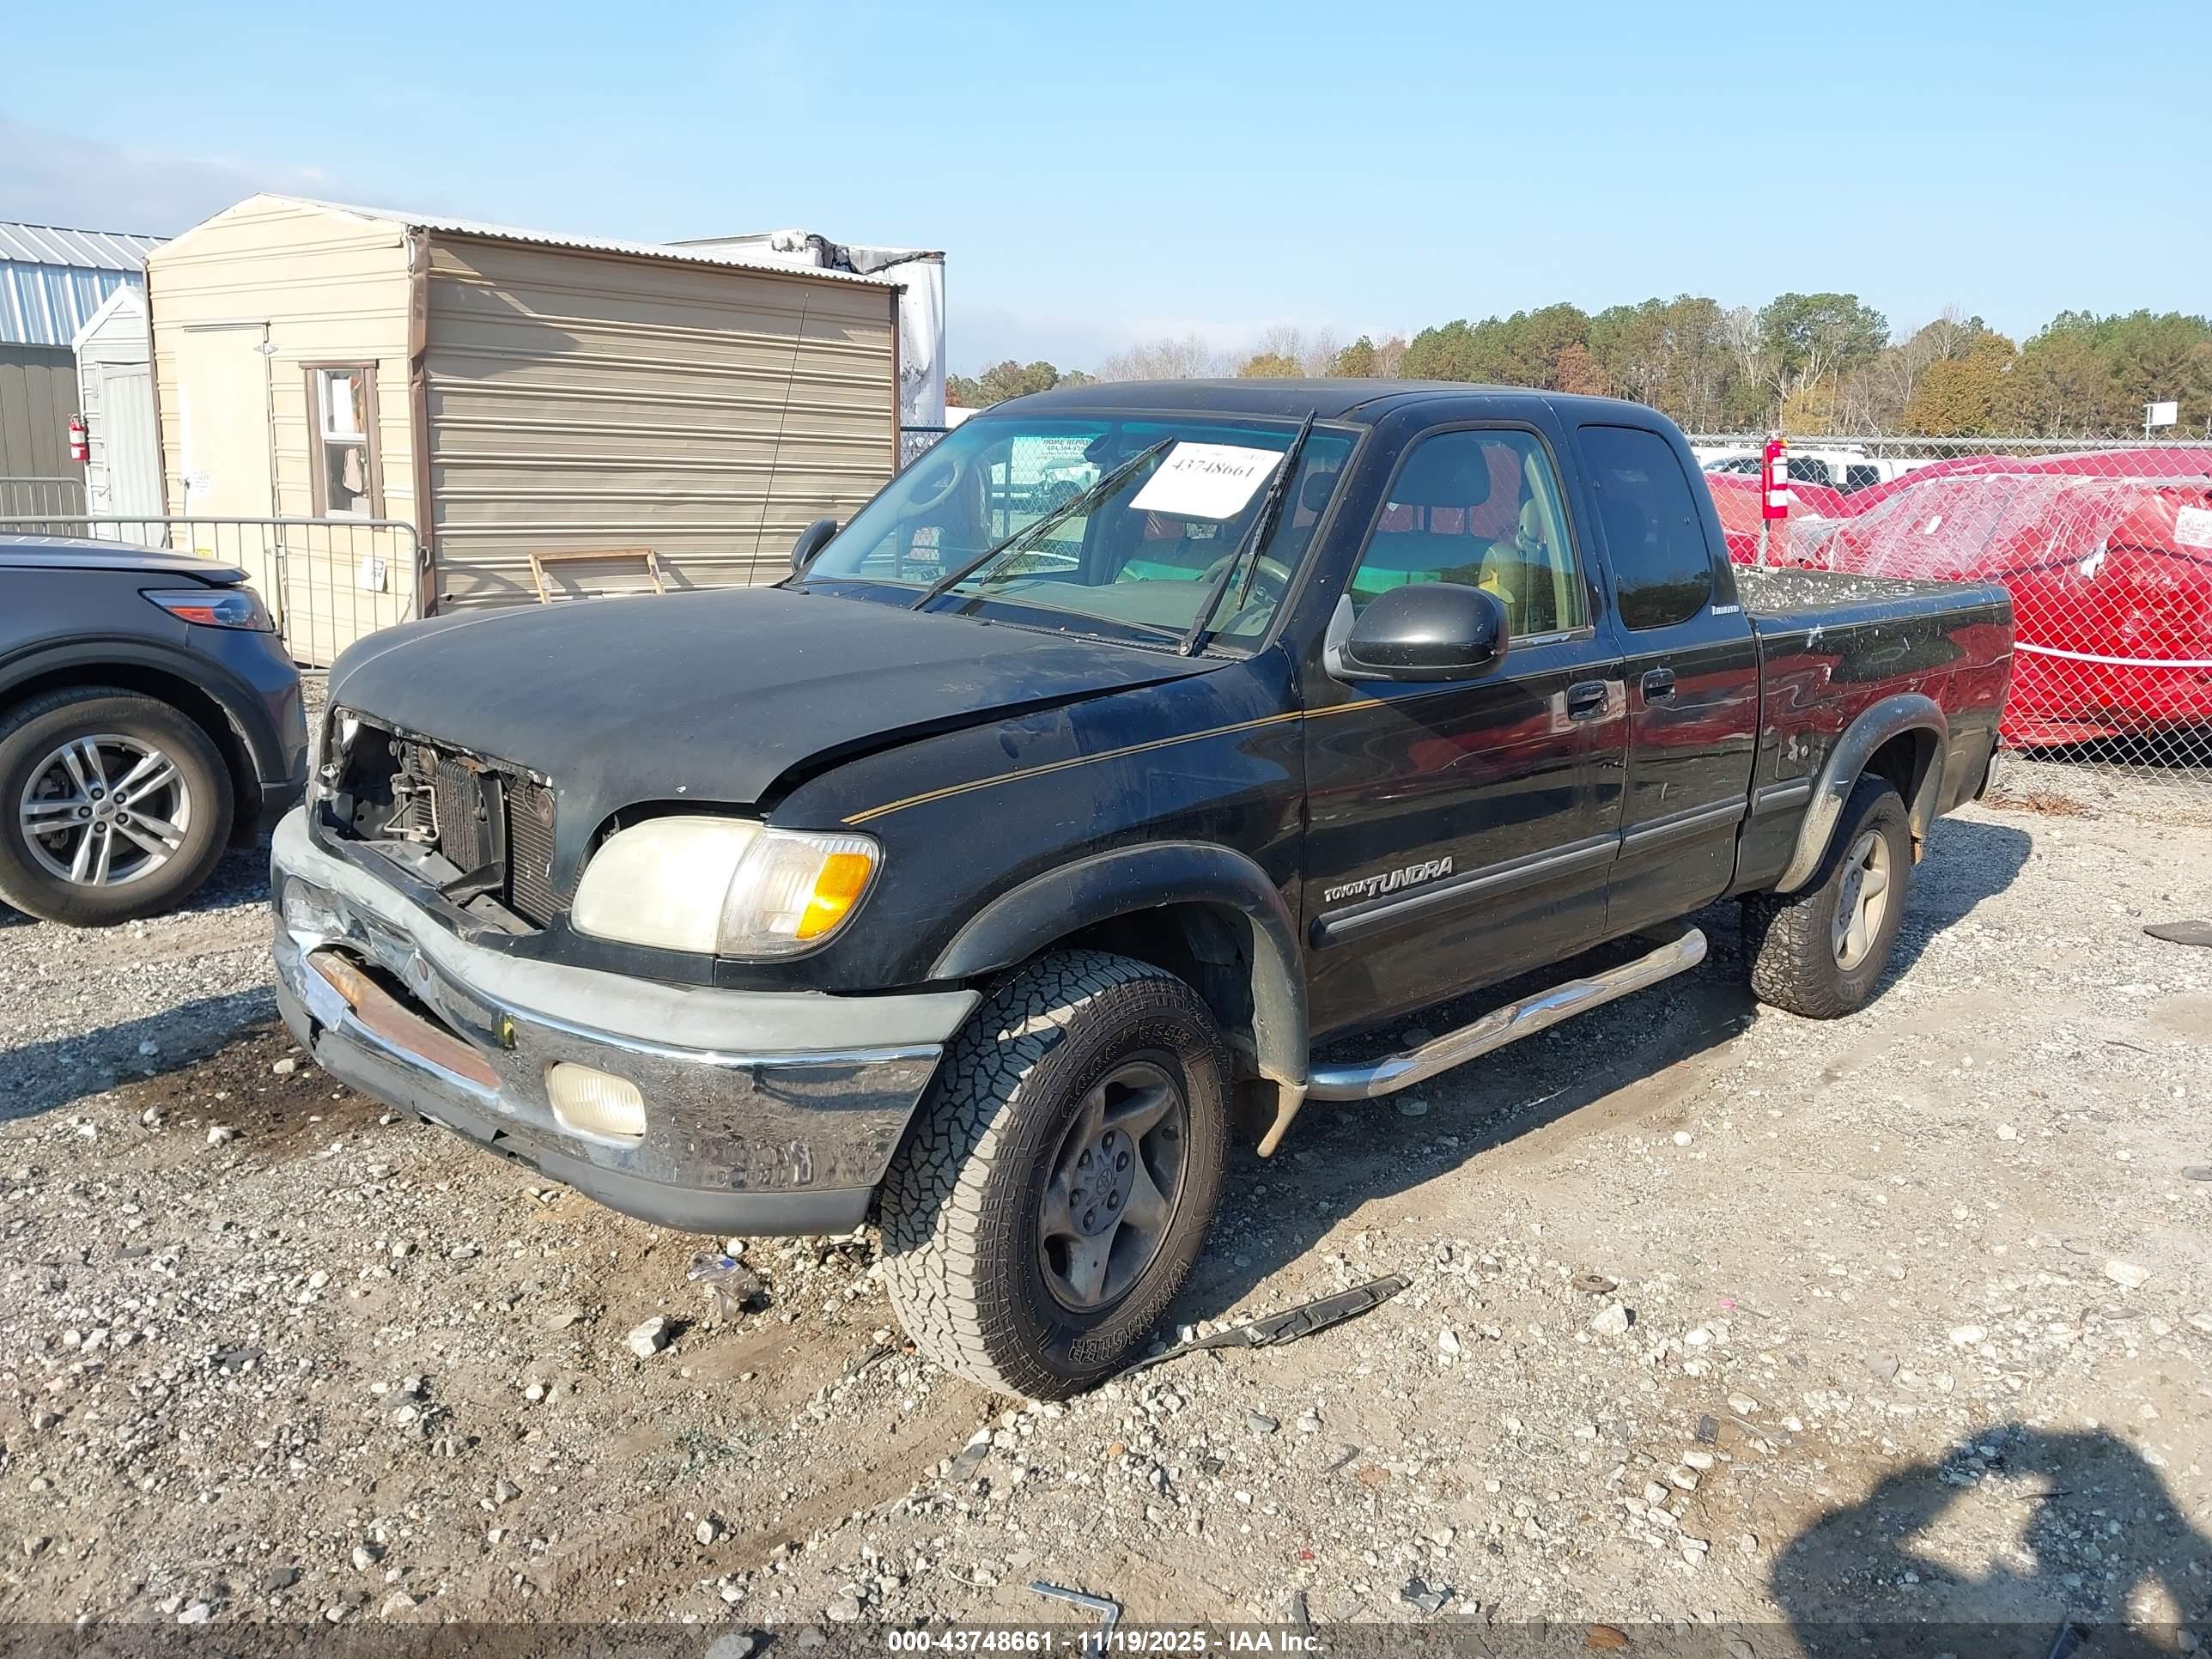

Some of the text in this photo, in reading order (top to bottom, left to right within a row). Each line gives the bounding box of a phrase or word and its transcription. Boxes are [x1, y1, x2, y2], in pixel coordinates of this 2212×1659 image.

[1172, 459, 1255, 477] 43748661
[1324, 856, 1454, 902] TOYOTA TUNDRA
[1067, 1257, 1192, 1365] WRANGLER
